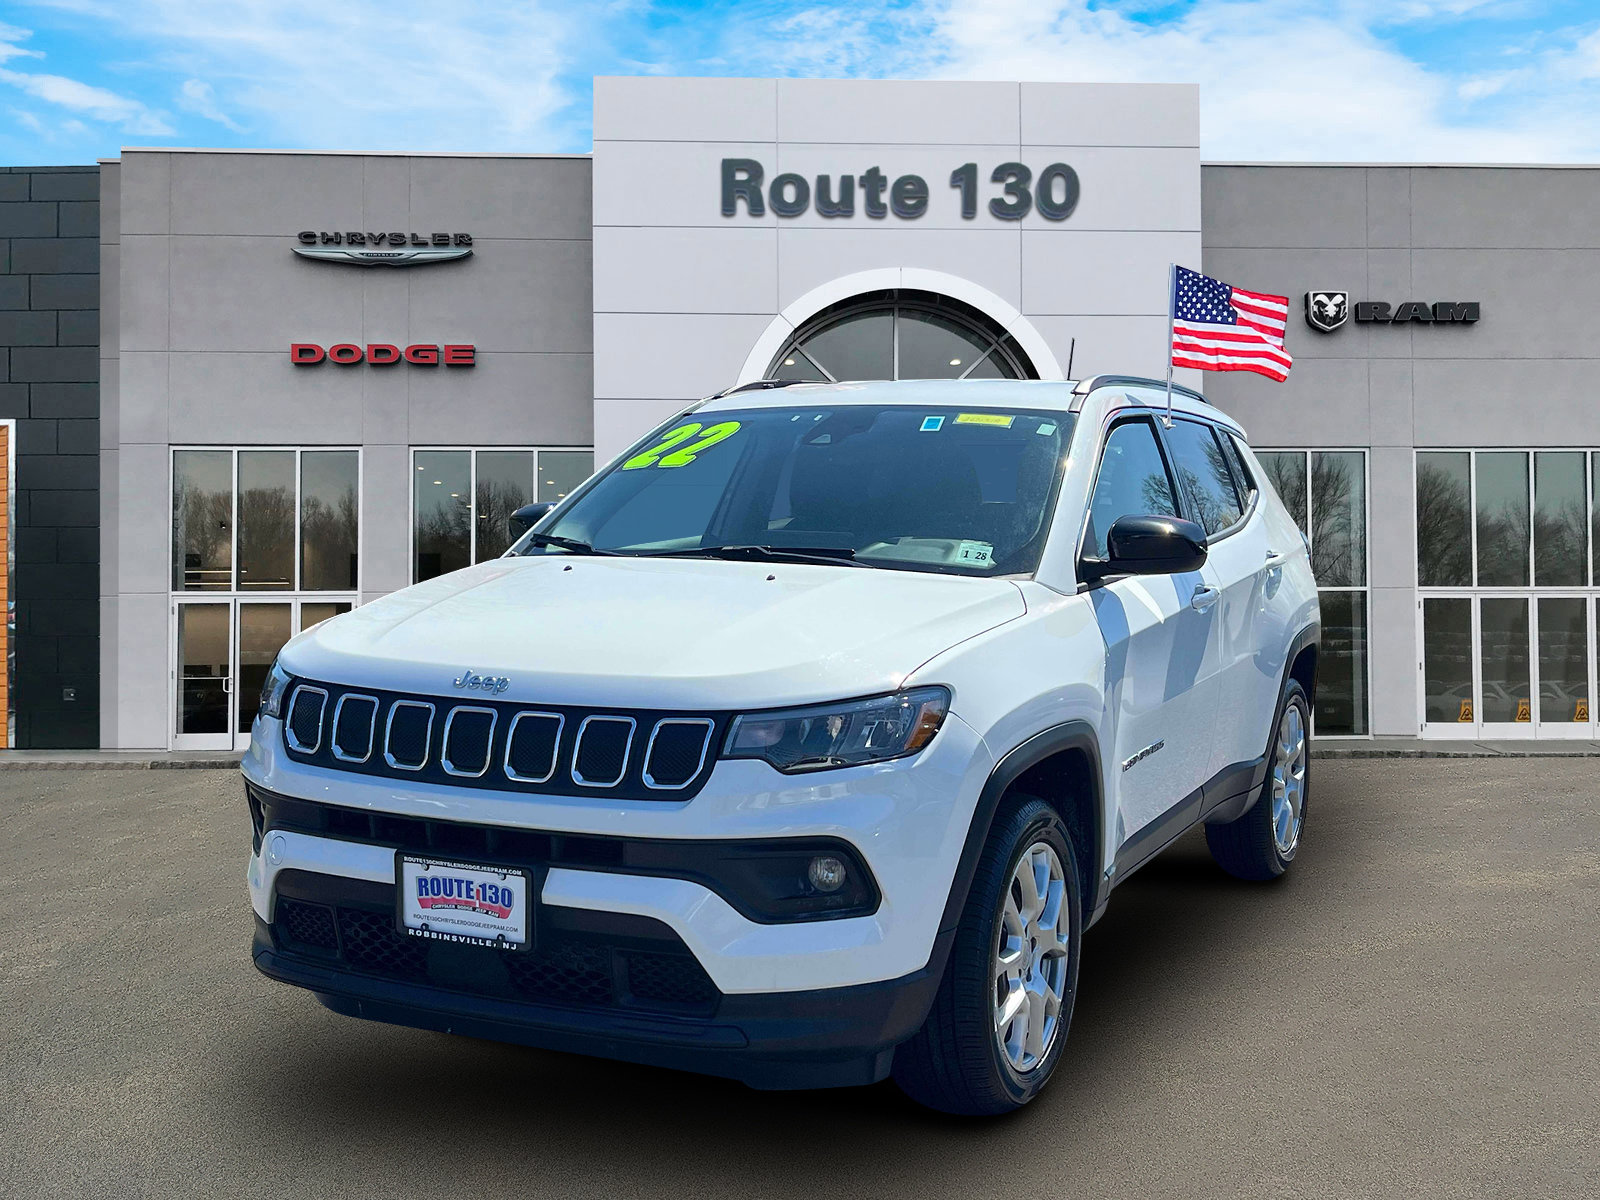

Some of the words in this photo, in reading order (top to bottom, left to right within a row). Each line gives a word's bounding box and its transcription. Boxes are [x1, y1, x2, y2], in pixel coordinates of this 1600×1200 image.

[721, 158, 929, 218] Route
[950, 161, 1080, 220] 130
[298, 231, 473, 246] CHRYSLER
[1355, 302, 1480, 324] RAM
[291, 343, 476, 365] DODGE
[622, 421, 741, 470] 22
[963, 550, 969, 558] 1
[975, 552, 987, 560] 28
[453, 669, 511, 696] Jeep
[404, 857, 522, 875] ROUTE130CHRYSLERDODGEJEEPRAM.COM
[417, 877, 475, 899] ROUTE
[479, 883, 512, 908] 130
[408, 928, 498, 948] ROBBINSVILLE,
[502, 942, 517, 951] NJ
